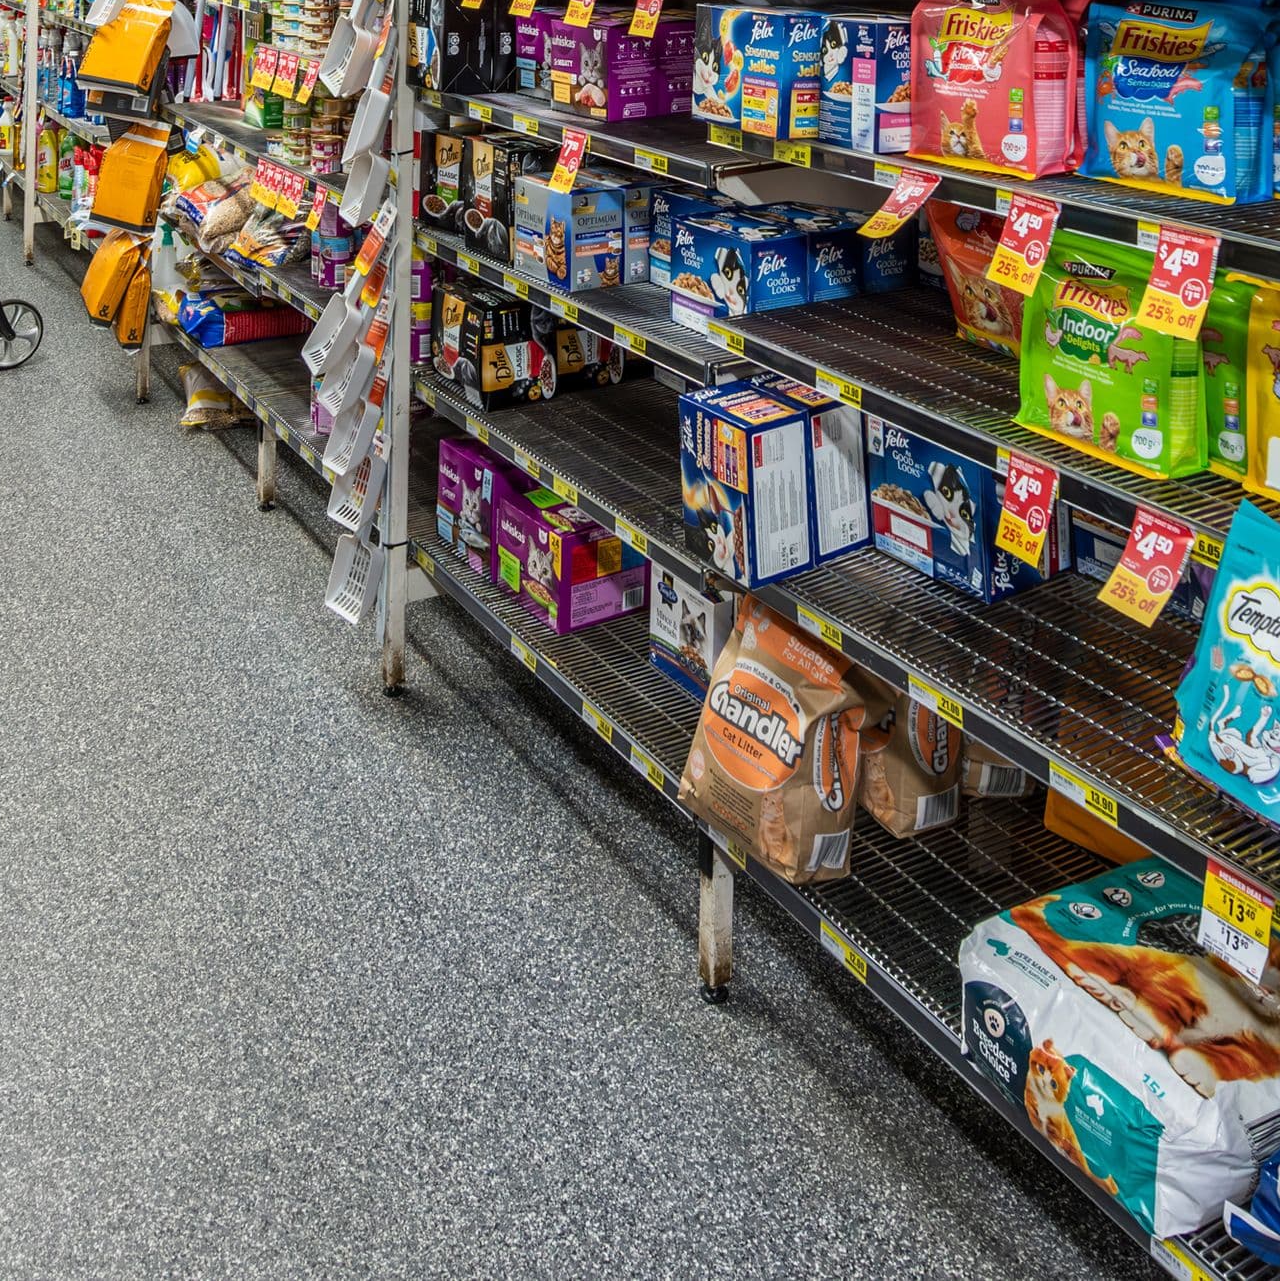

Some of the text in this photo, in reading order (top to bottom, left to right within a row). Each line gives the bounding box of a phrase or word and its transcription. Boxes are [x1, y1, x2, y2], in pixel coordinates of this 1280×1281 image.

[1143, 5, 1195, 20] PURINA
[750, 23, 774, 44] felix
[945, 15, 1007, 39] Friskies
[1119, 28, 1197, 57] Friskies
[1123, 59, 1178, 79] Seafood
[440, 144, 460, 166] Dine
[439, 170, 458, 179] CLASSIC
[578, 215, 617, 226] OPTIMUM
[757, 255, 787, 281] felix
[1071, 264, 1111, 278] PURINA
[772, 284, 796, 294] LOOKS
[1056, 280, 1129, 317] Friskies
[1146, 303, 1196, 329] 25% off
[1062, 315, 1115, 344] Indoor
[1066, 334, 1101, 352] Delights
[496, 349, 512, 383] Dine
[1199, 542, 1220, 557] 6.05
[1110, 581, 1158, 611] 25% off
[734, 683, 770, 712] Original
[708, 682, 803, 765] Chandler
[722, 727, 764, 761] Cat Litter
[1090, 790, 1114, 814] 13.90
[1219, 870, 1246, 891] MEMBER
[1247, 887, 1262, 902] DEAL
[972, 1020, 1017, 1074] Breeder's
[979, 1041, 1010, 1083] Choice
